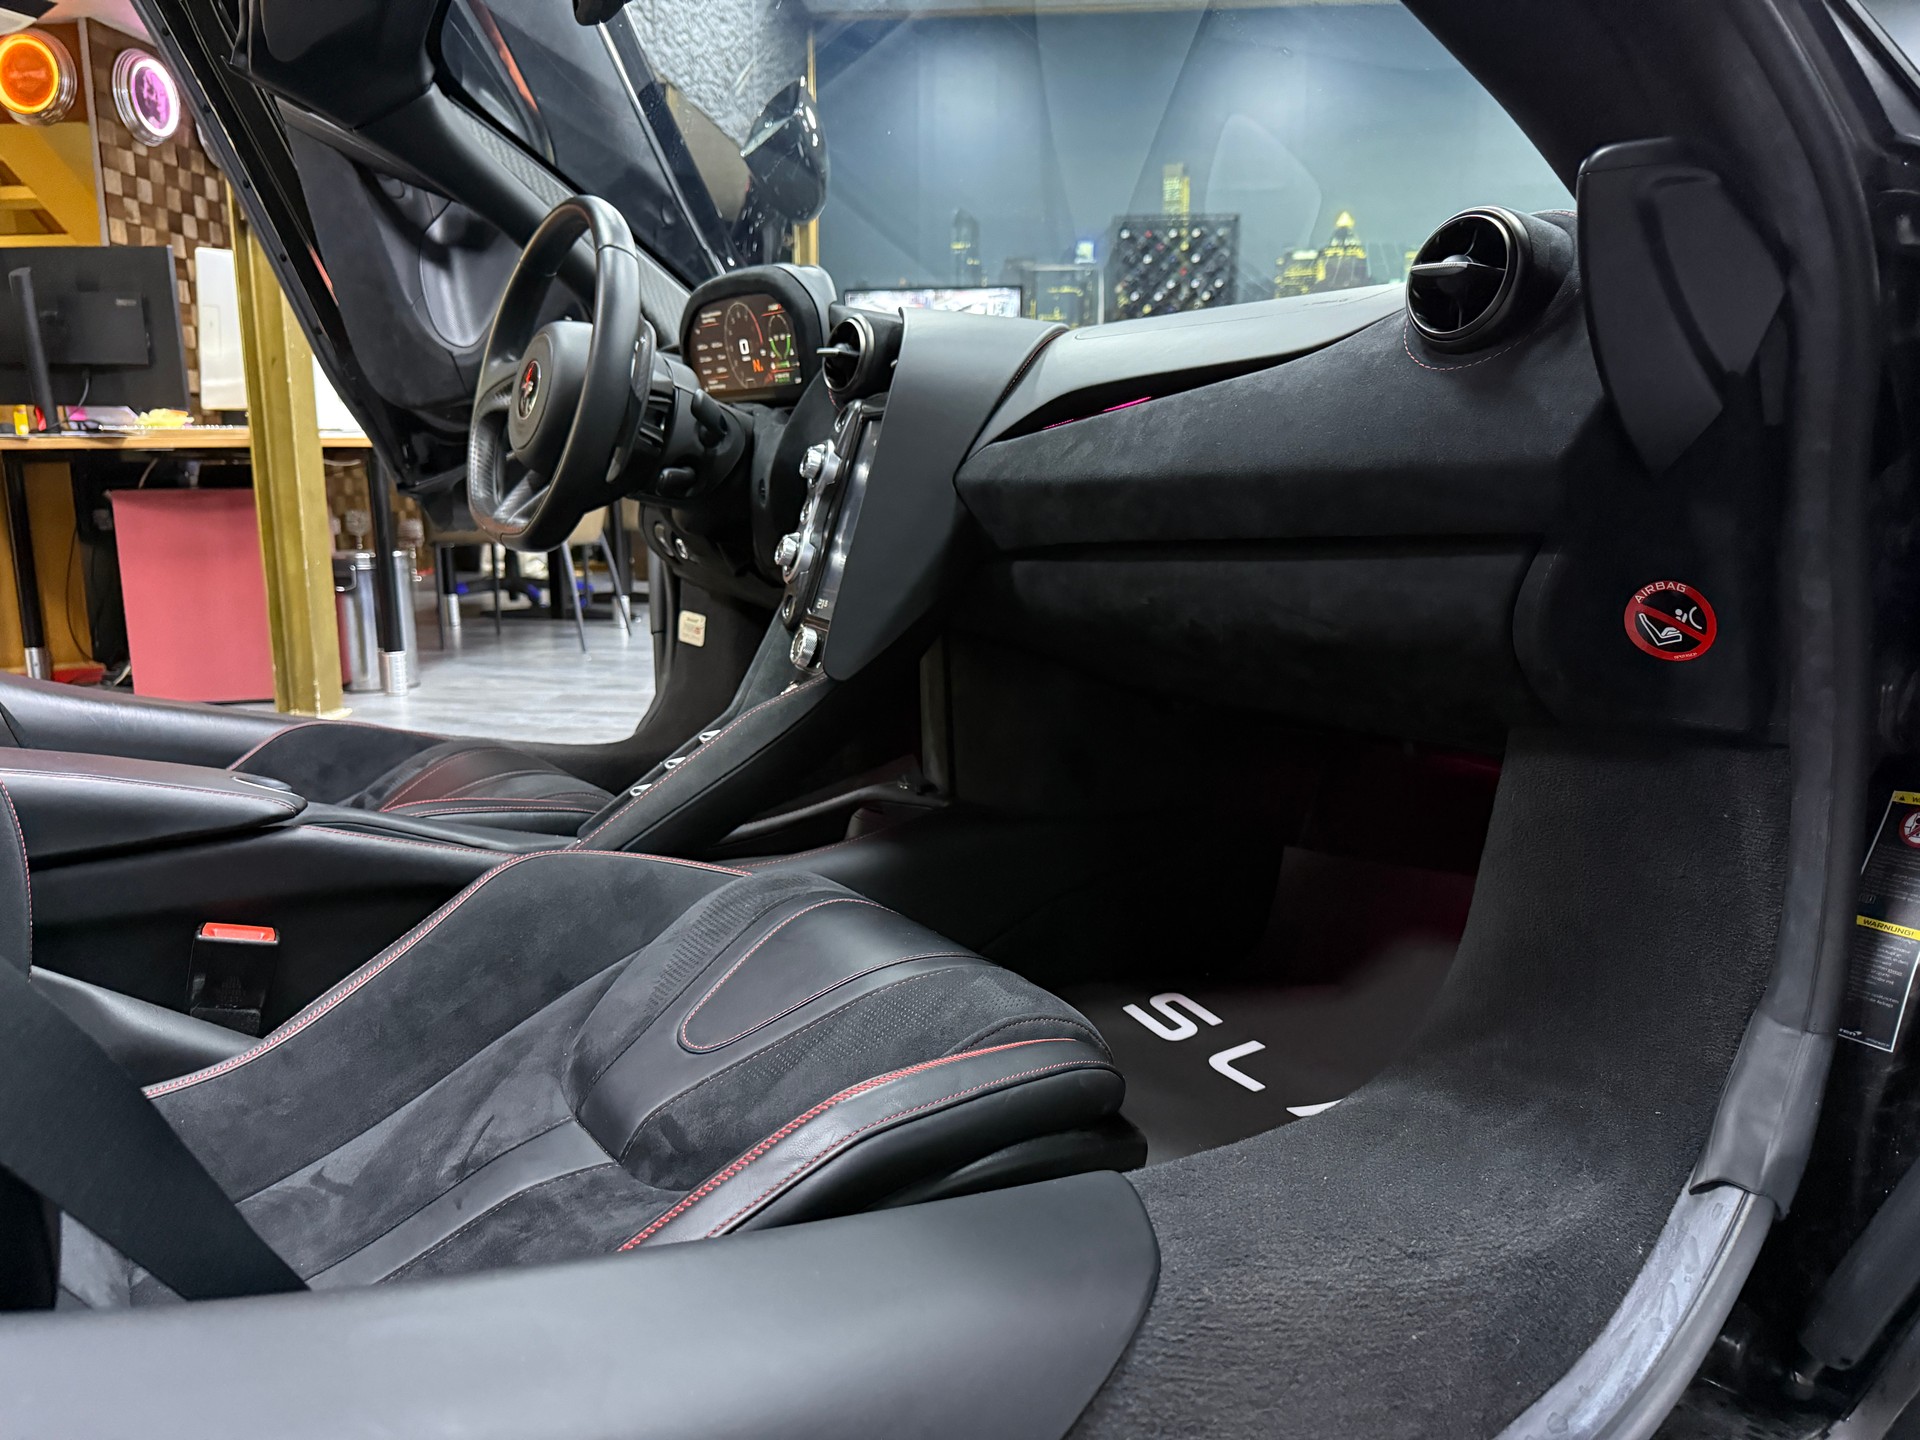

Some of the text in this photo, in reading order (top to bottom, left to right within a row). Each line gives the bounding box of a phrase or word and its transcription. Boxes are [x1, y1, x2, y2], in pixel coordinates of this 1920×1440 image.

[738, 338, 750, 355] 0
[1634, 581, 1687, 604] AIRBAG
[1862, 918, 1914, 937] WARNUNG!
